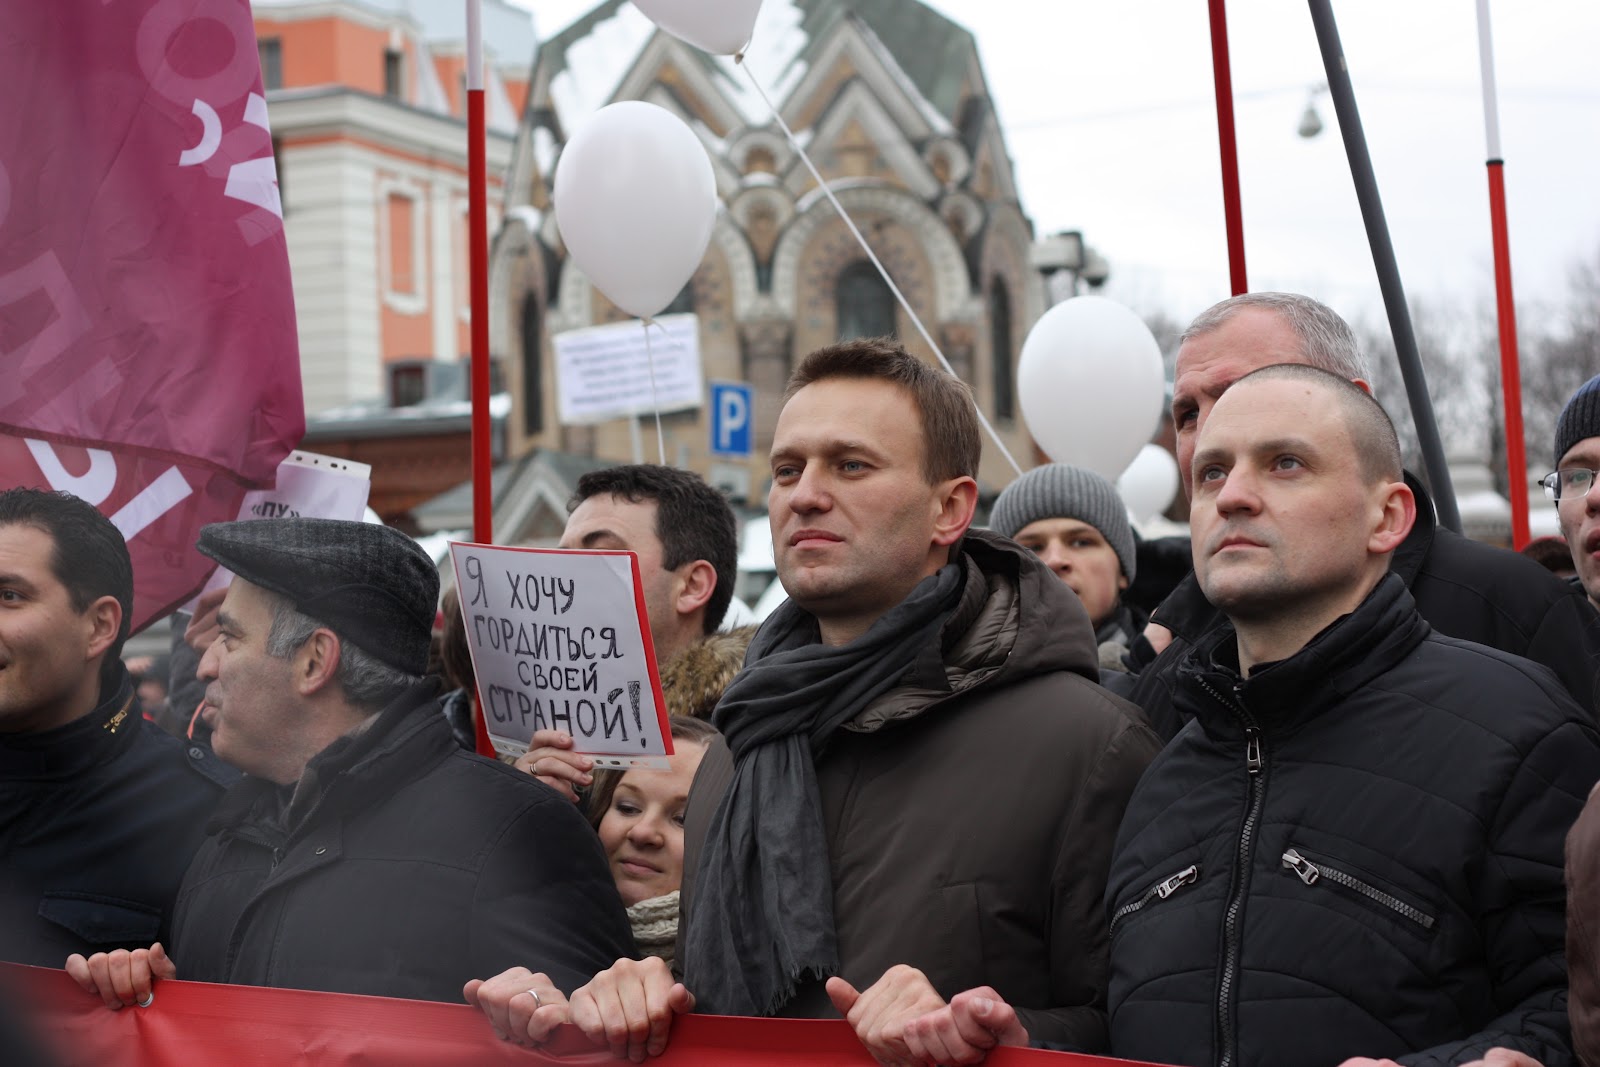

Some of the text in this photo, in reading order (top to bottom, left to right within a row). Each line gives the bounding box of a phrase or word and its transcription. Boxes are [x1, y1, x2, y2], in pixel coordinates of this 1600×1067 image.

[719, 390, 746, 448] P
[465, 555, 575, 615] Я ХОЧУ
[473, 614, 624, 661] ГОРДИТЬСЯ
[517, 660, 598, 694] СВОЕЙ
[487, 680, 647, 749] СТРАНОЙ!
